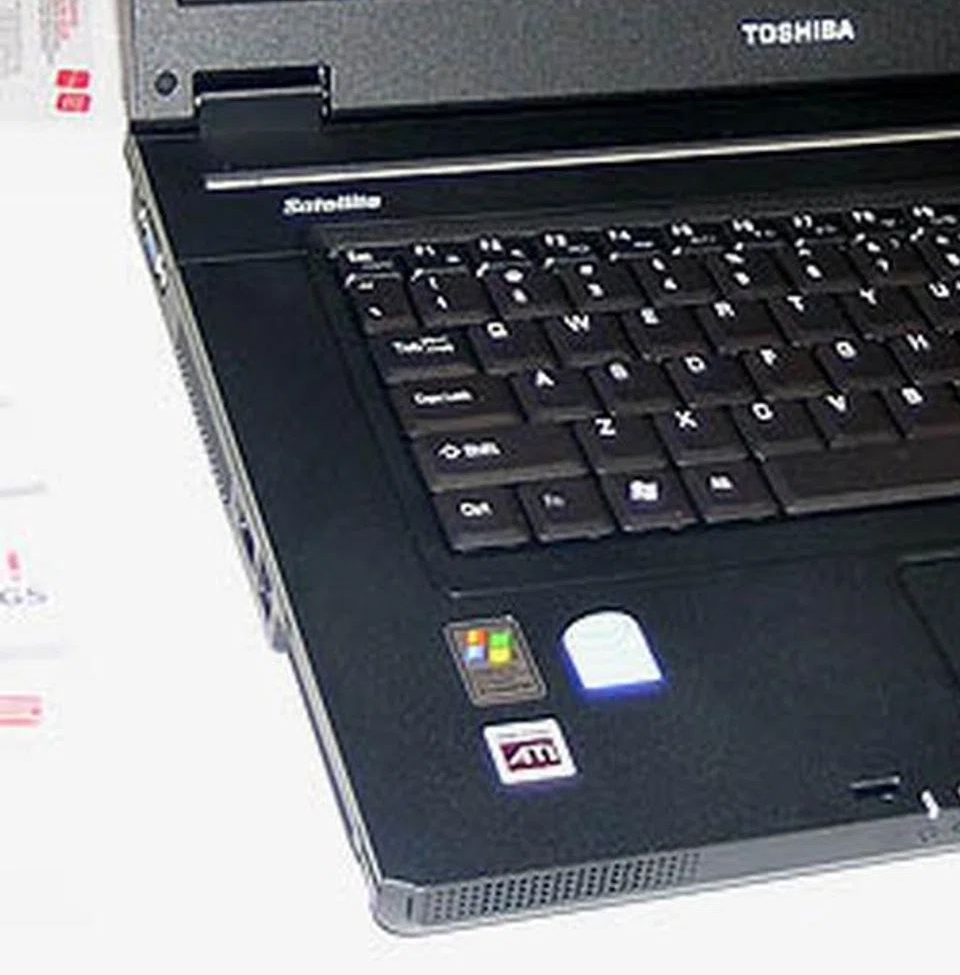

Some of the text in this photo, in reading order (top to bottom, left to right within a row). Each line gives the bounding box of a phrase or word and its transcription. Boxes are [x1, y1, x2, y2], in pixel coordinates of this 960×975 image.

[740, 18, 856, 46] TOSHIBA
[563, 314, 590, 332] W
[786, 295, 804, 312] T
[859, 288, 877, 305] Y
[928, 282, 950, 298] U
[535, 369, 555, 387] A
[594, 418, 617, 436] Z
[674, 410, 698, 428] X
[826, 395, 846, 412] V
